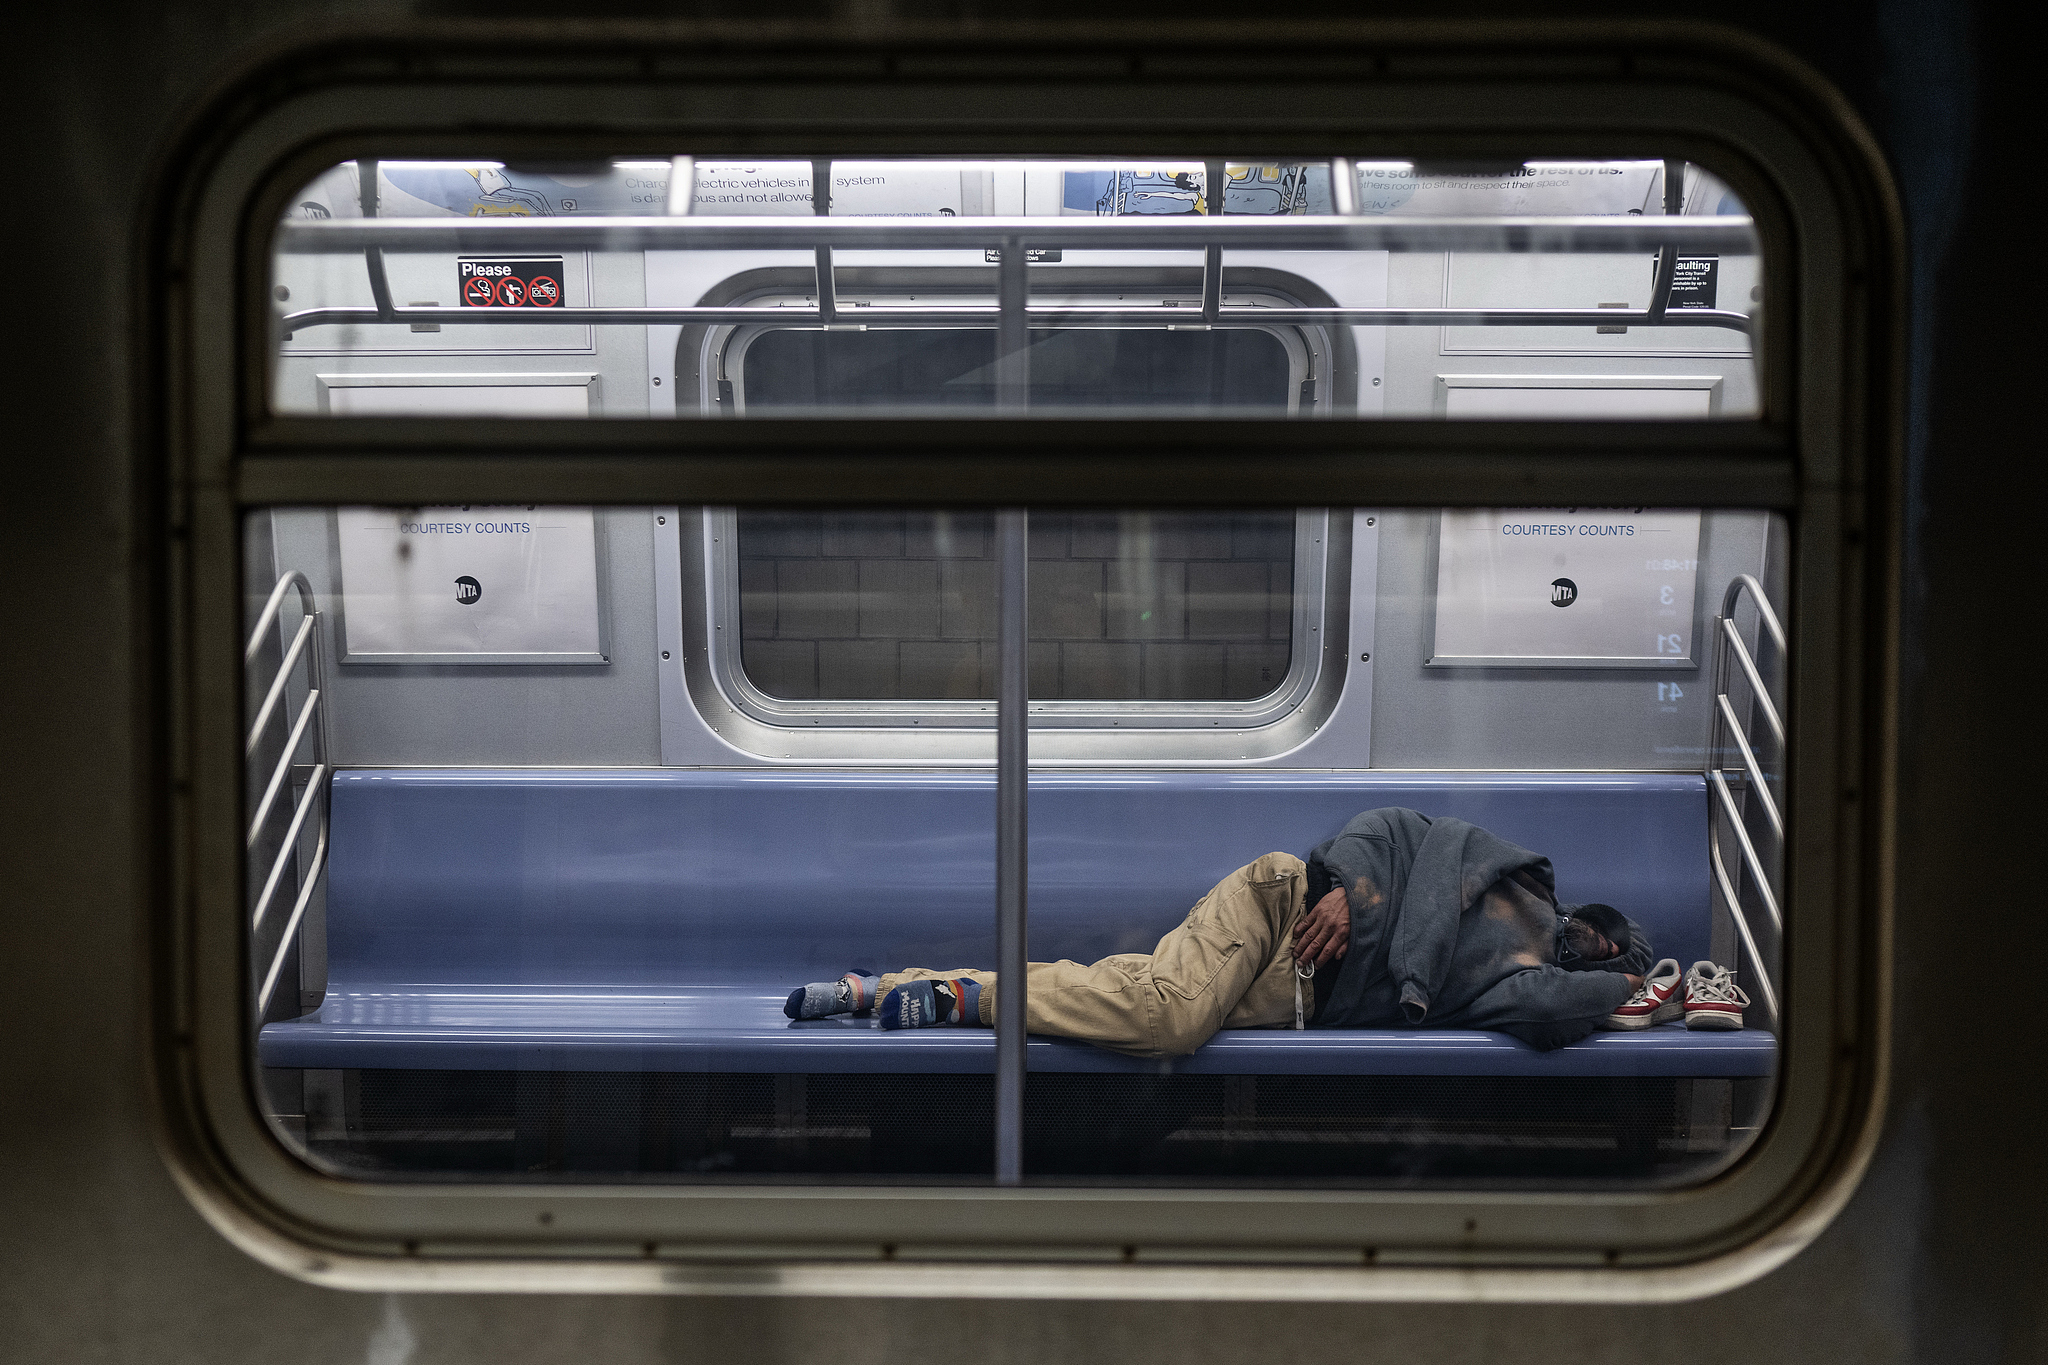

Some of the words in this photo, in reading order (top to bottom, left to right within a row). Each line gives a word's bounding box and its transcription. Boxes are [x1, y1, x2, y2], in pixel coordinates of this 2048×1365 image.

[741, 178, 796, 189] vehicles
[798, 177, 810, 188] in
[836, 175, 886, 188] system
[1422, 181, 1432, 190] to
[1433, 180, 1446, 189] sit
[1448, 181, 1468, 190] and
[1470, 181, 1510, 191] respect
[1512, 180, 1535, 189] their
[1536, 179, 1571, 189] space.
[630, 192, 642, 203] is
[718, 192, 743, 203] and
[746, 192, 768, 203] not
[770, 191, 814, 203] allowe
[461, 262, 512, 277] Please
[1676, 261, 1711, 272] aulting
[401, 522, 472, 534] COURTESY
[475, 522, 531, 534] COUNTS
[1502, 524, 1576, 536] COURTESY
[1579, 525, 1635, 537] COUNTS
